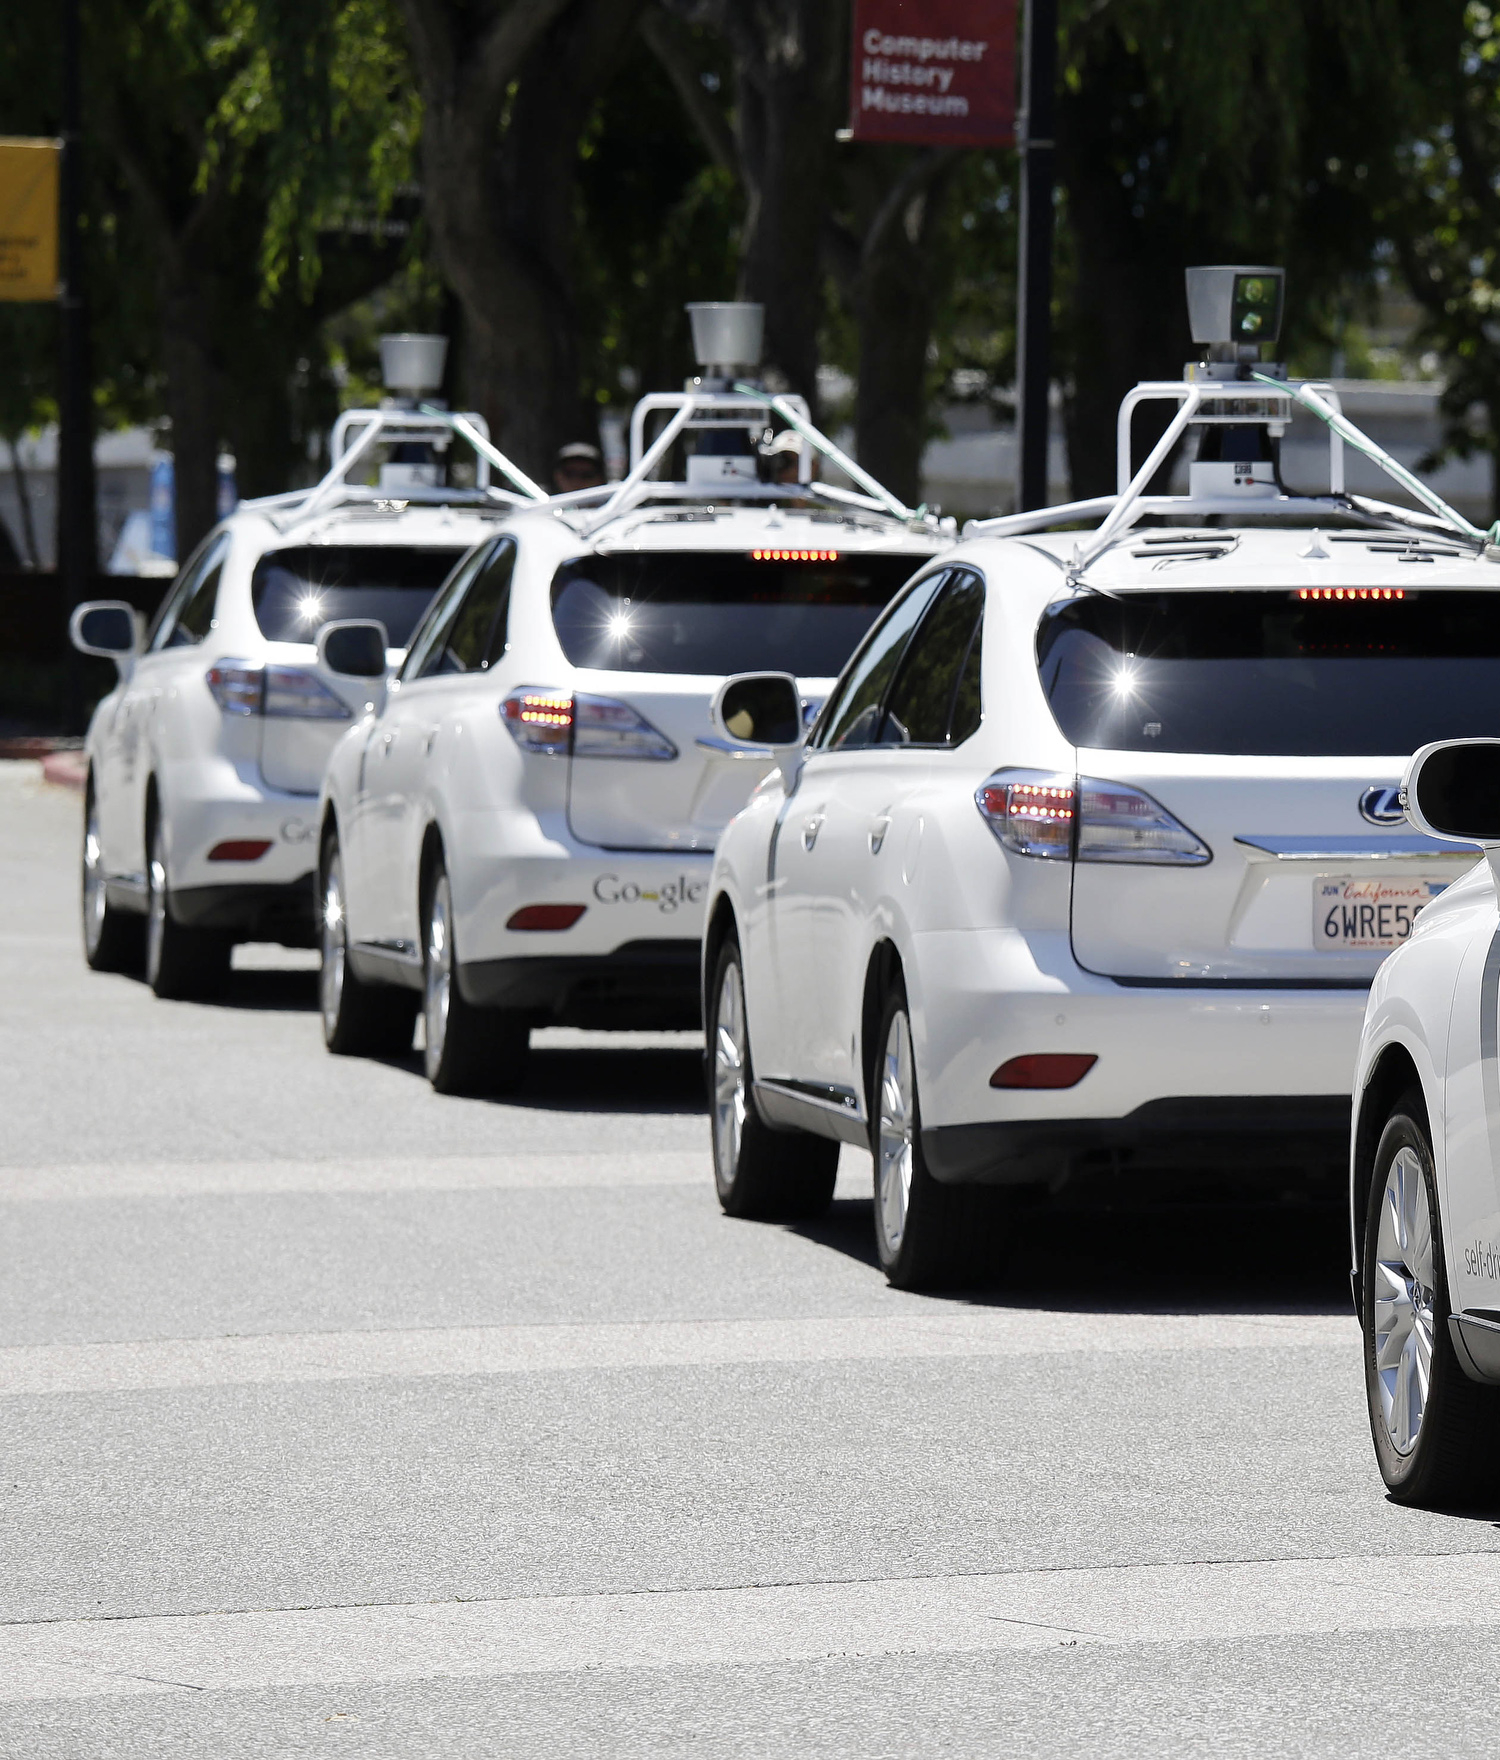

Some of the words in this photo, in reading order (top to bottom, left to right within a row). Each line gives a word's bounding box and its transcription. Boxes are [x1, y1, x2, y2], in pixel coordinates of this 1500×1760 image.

[863, 28, 988, 62] Computer
[861, 58, 954, 93] History
[861, 86, 969, 117] Museum
[1321, 886, 1339, 896] JUN
[1343, 882, 1429, 903] California
[1324, 905, 1423, 939] 6WRE5
